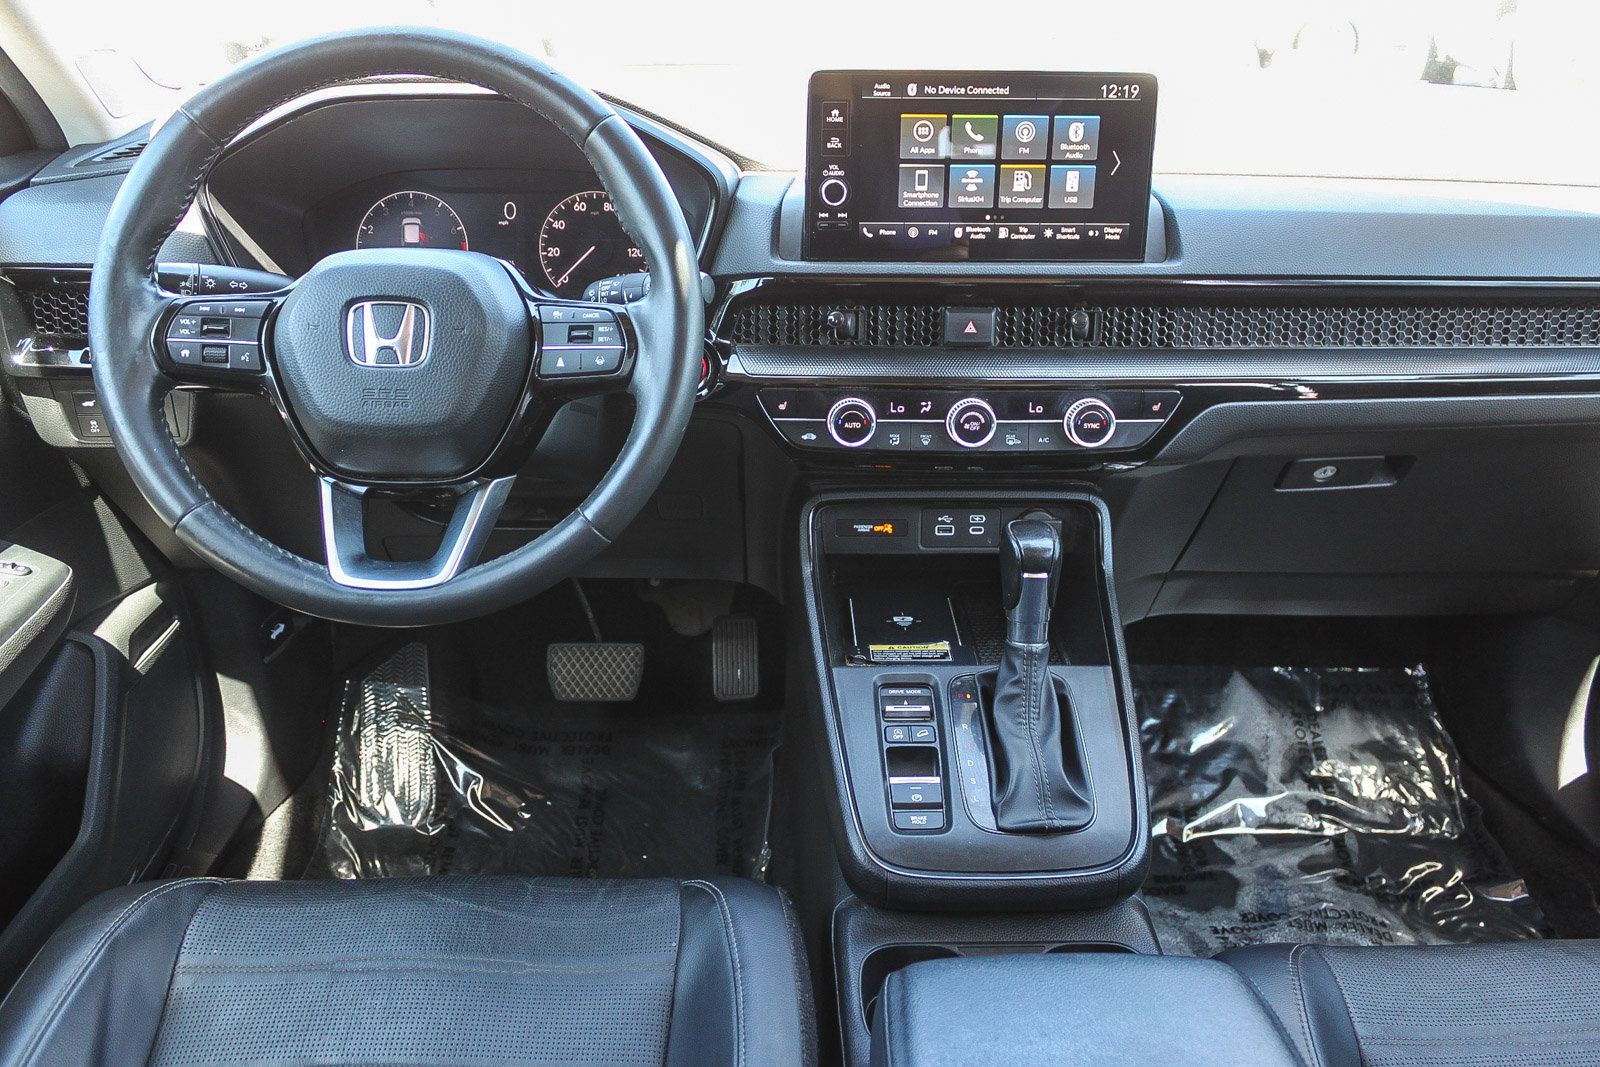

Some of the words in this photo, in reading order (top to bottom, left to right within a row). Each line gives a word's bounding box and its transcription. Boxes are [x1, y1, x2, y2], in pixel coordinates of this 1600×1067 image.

[924, 85, 936, 94] No
[938, 85, 965, 95] Device
[967, 86, 1010, 95] Connected
[1100, 84, 1140, 99] 12:19
[920, 146, 936, 154] Apps
[903, 191, 939, 199] Smartphone
[504, 202, 517, 220] 0
[574, 202, 586, 211] 60
[604, 203, 615, 211] 80
[383, 208, 389, 216] 3
[552, 220, 566, 229] 40
[368, 225, 373, 234] 2
[548, 247, 560, 257] 20
[627, 248, 643, 257] 120
